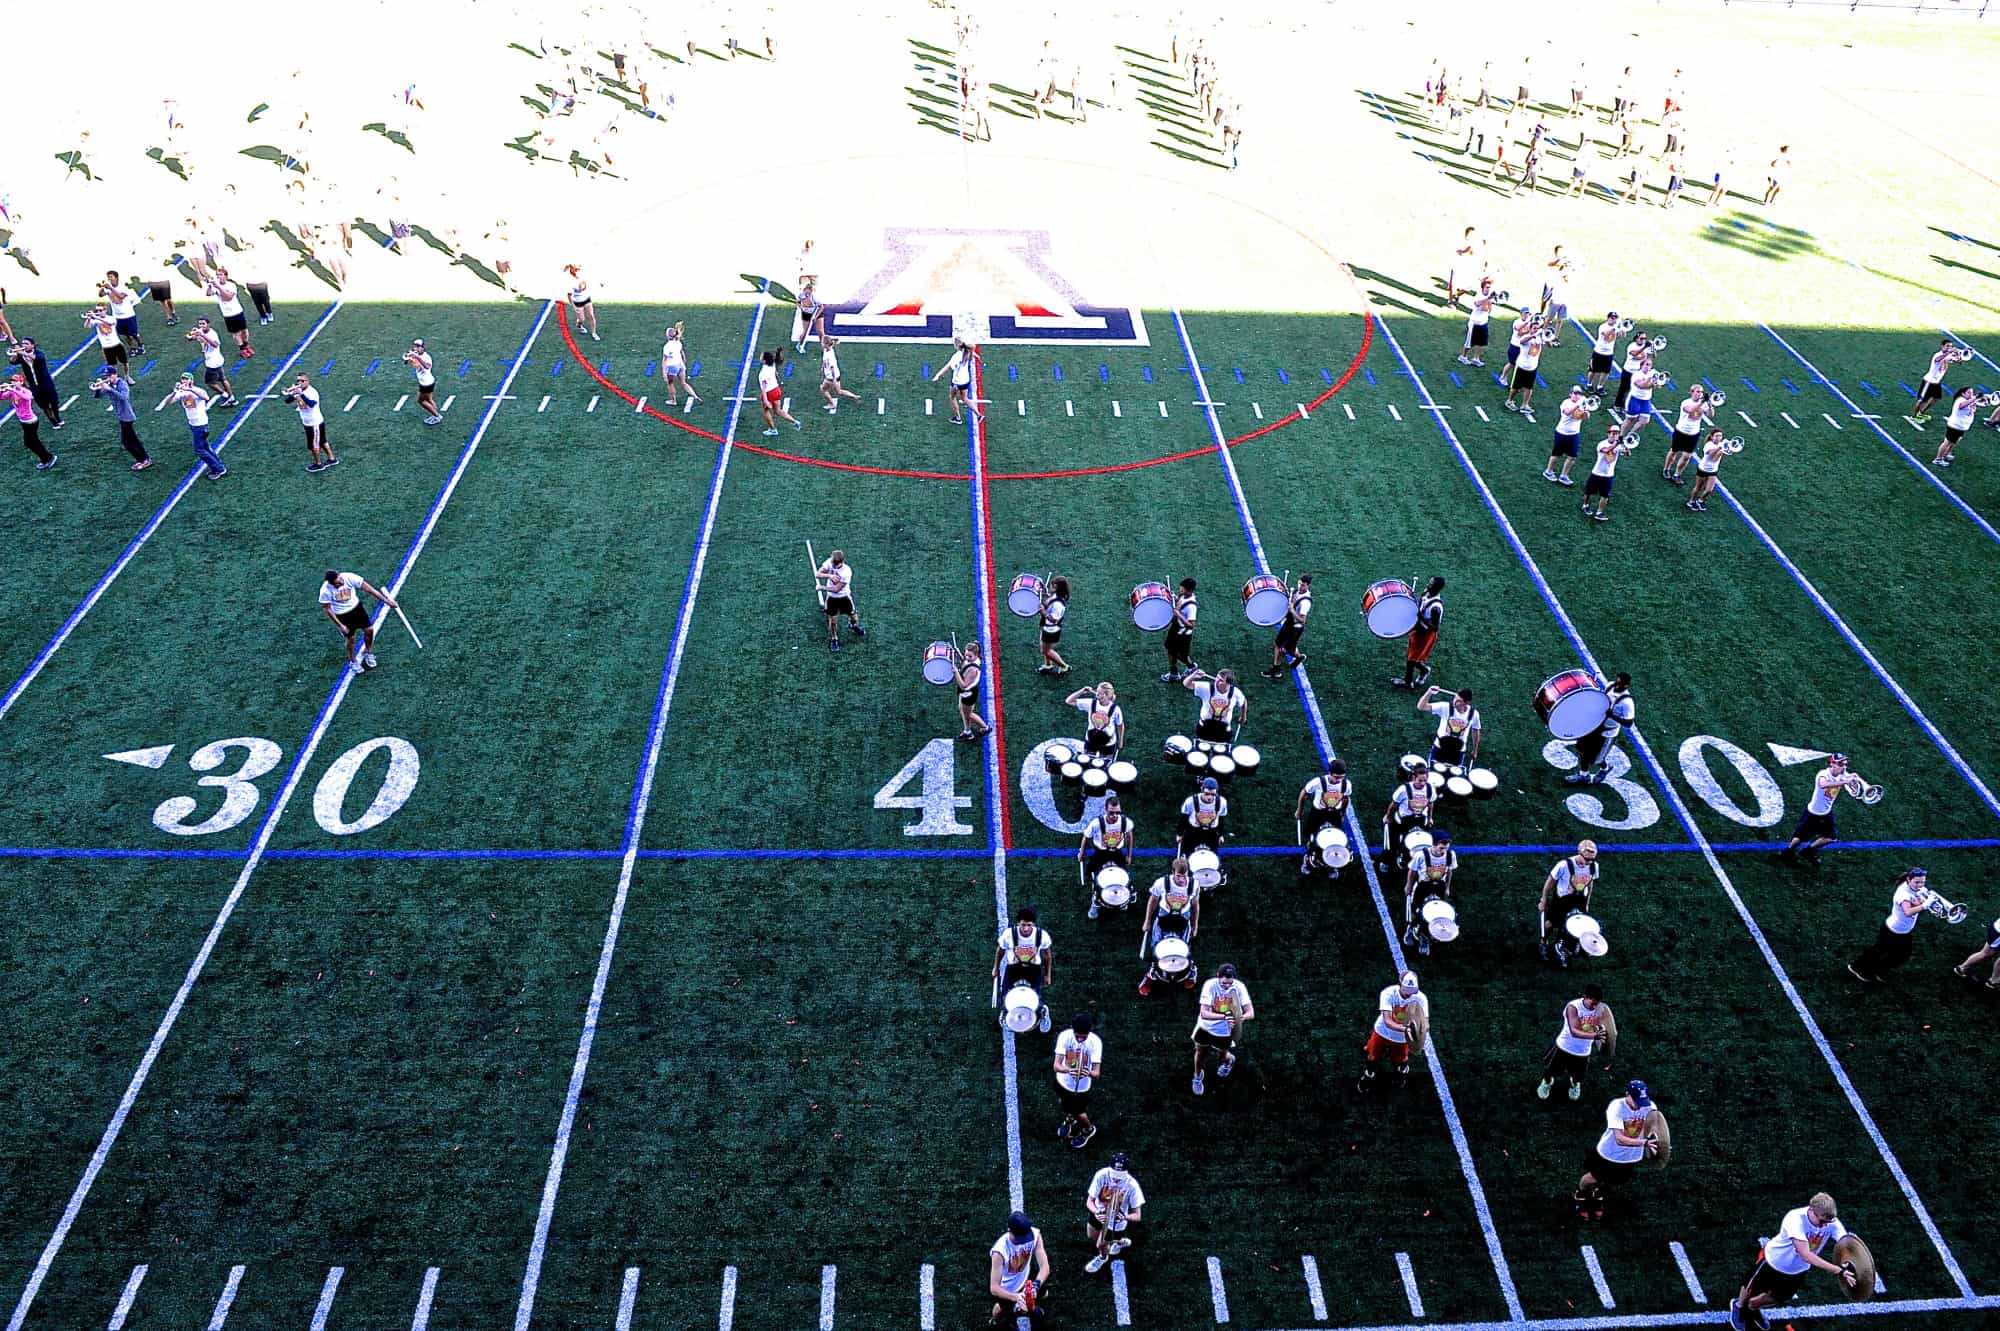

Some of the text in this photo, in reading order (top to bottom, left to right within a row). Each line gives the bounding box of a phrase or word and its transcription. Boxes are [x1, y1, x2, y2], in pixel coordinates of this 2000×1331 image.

[792, 227, 1149, 346] A
[152, 736, 420, 835] 30
[1542, 735, 1784, 830] 30
